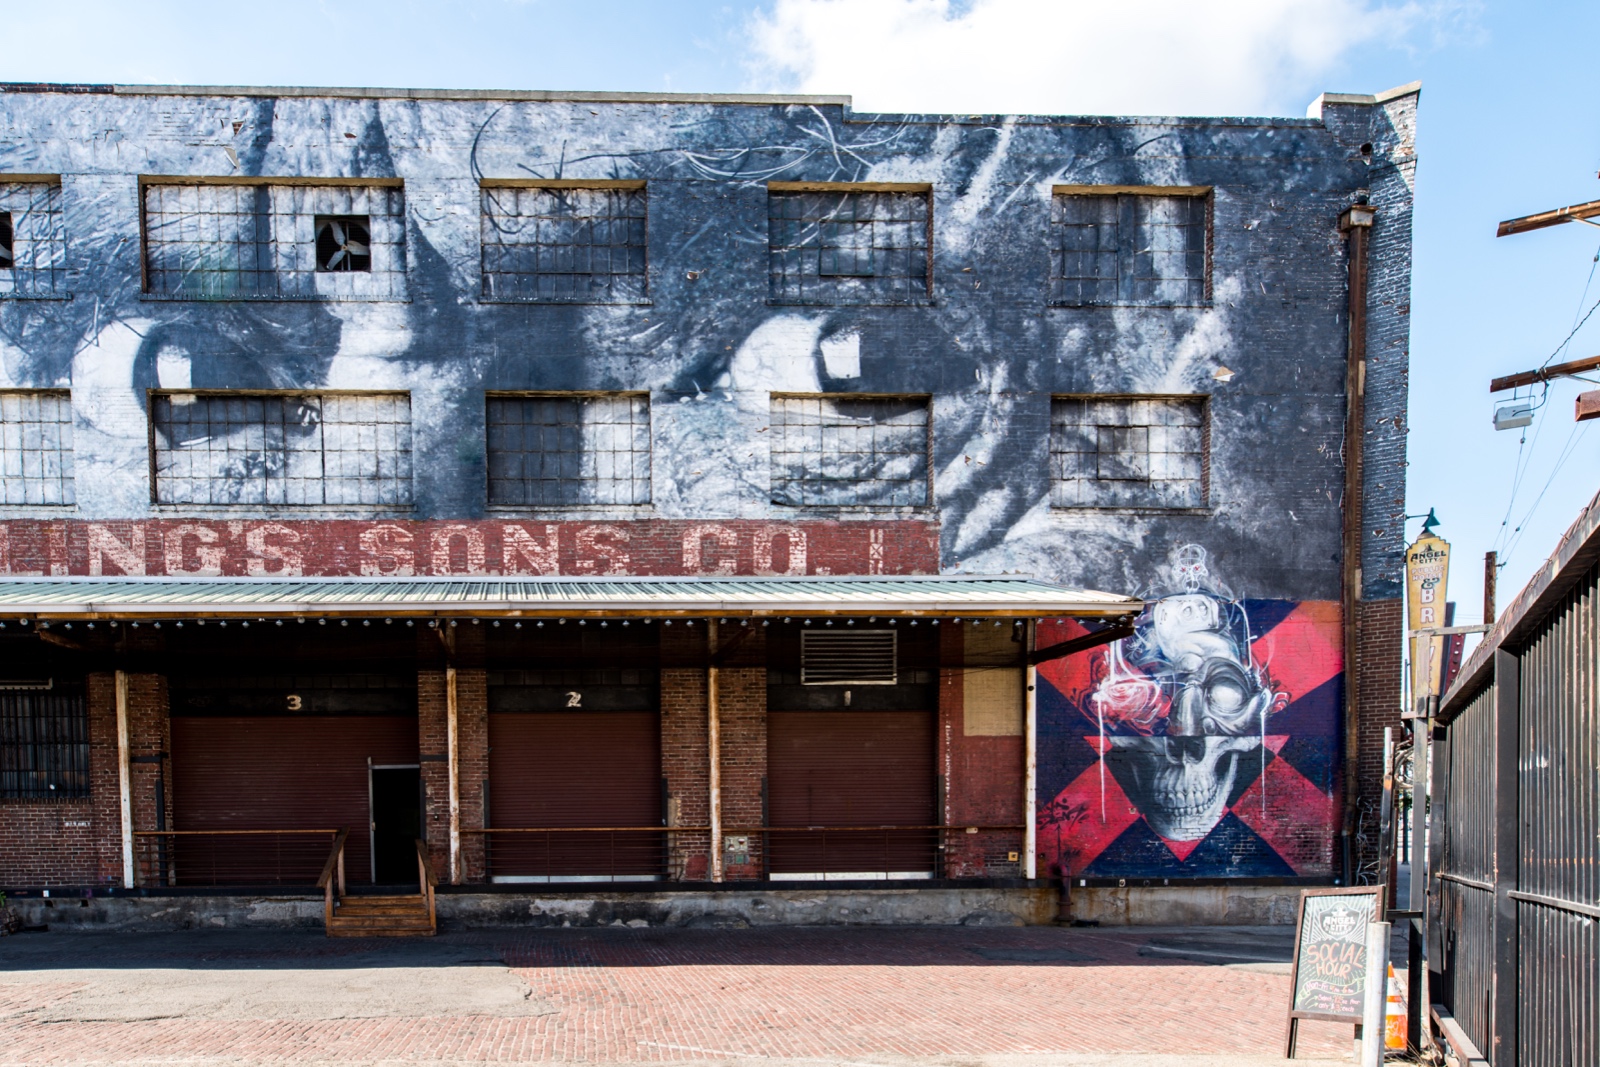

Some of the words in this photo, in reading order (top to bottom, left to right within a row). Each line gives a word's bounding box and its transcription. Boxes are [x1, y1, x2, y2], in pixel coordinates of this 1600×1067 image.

[359, 524, 630, 576] SONS
[1411, 550, 1447, 562] ANGEL
[1411, 565, 1445, 575] PUBLIC
[1412, 571, 1443, 581] HOUSE
[1421, 577, 1440, 590] &
[287, 695, 302, 710] 3
[565, 691, 582, 707] 2
[1322, 916, 1356, 928] ANGEL
[1330, 924, 1348, 932] CITY
[1307, 942, 1364, 969] SOCIAL
[1316, 961, 1351, 979] HOUR
